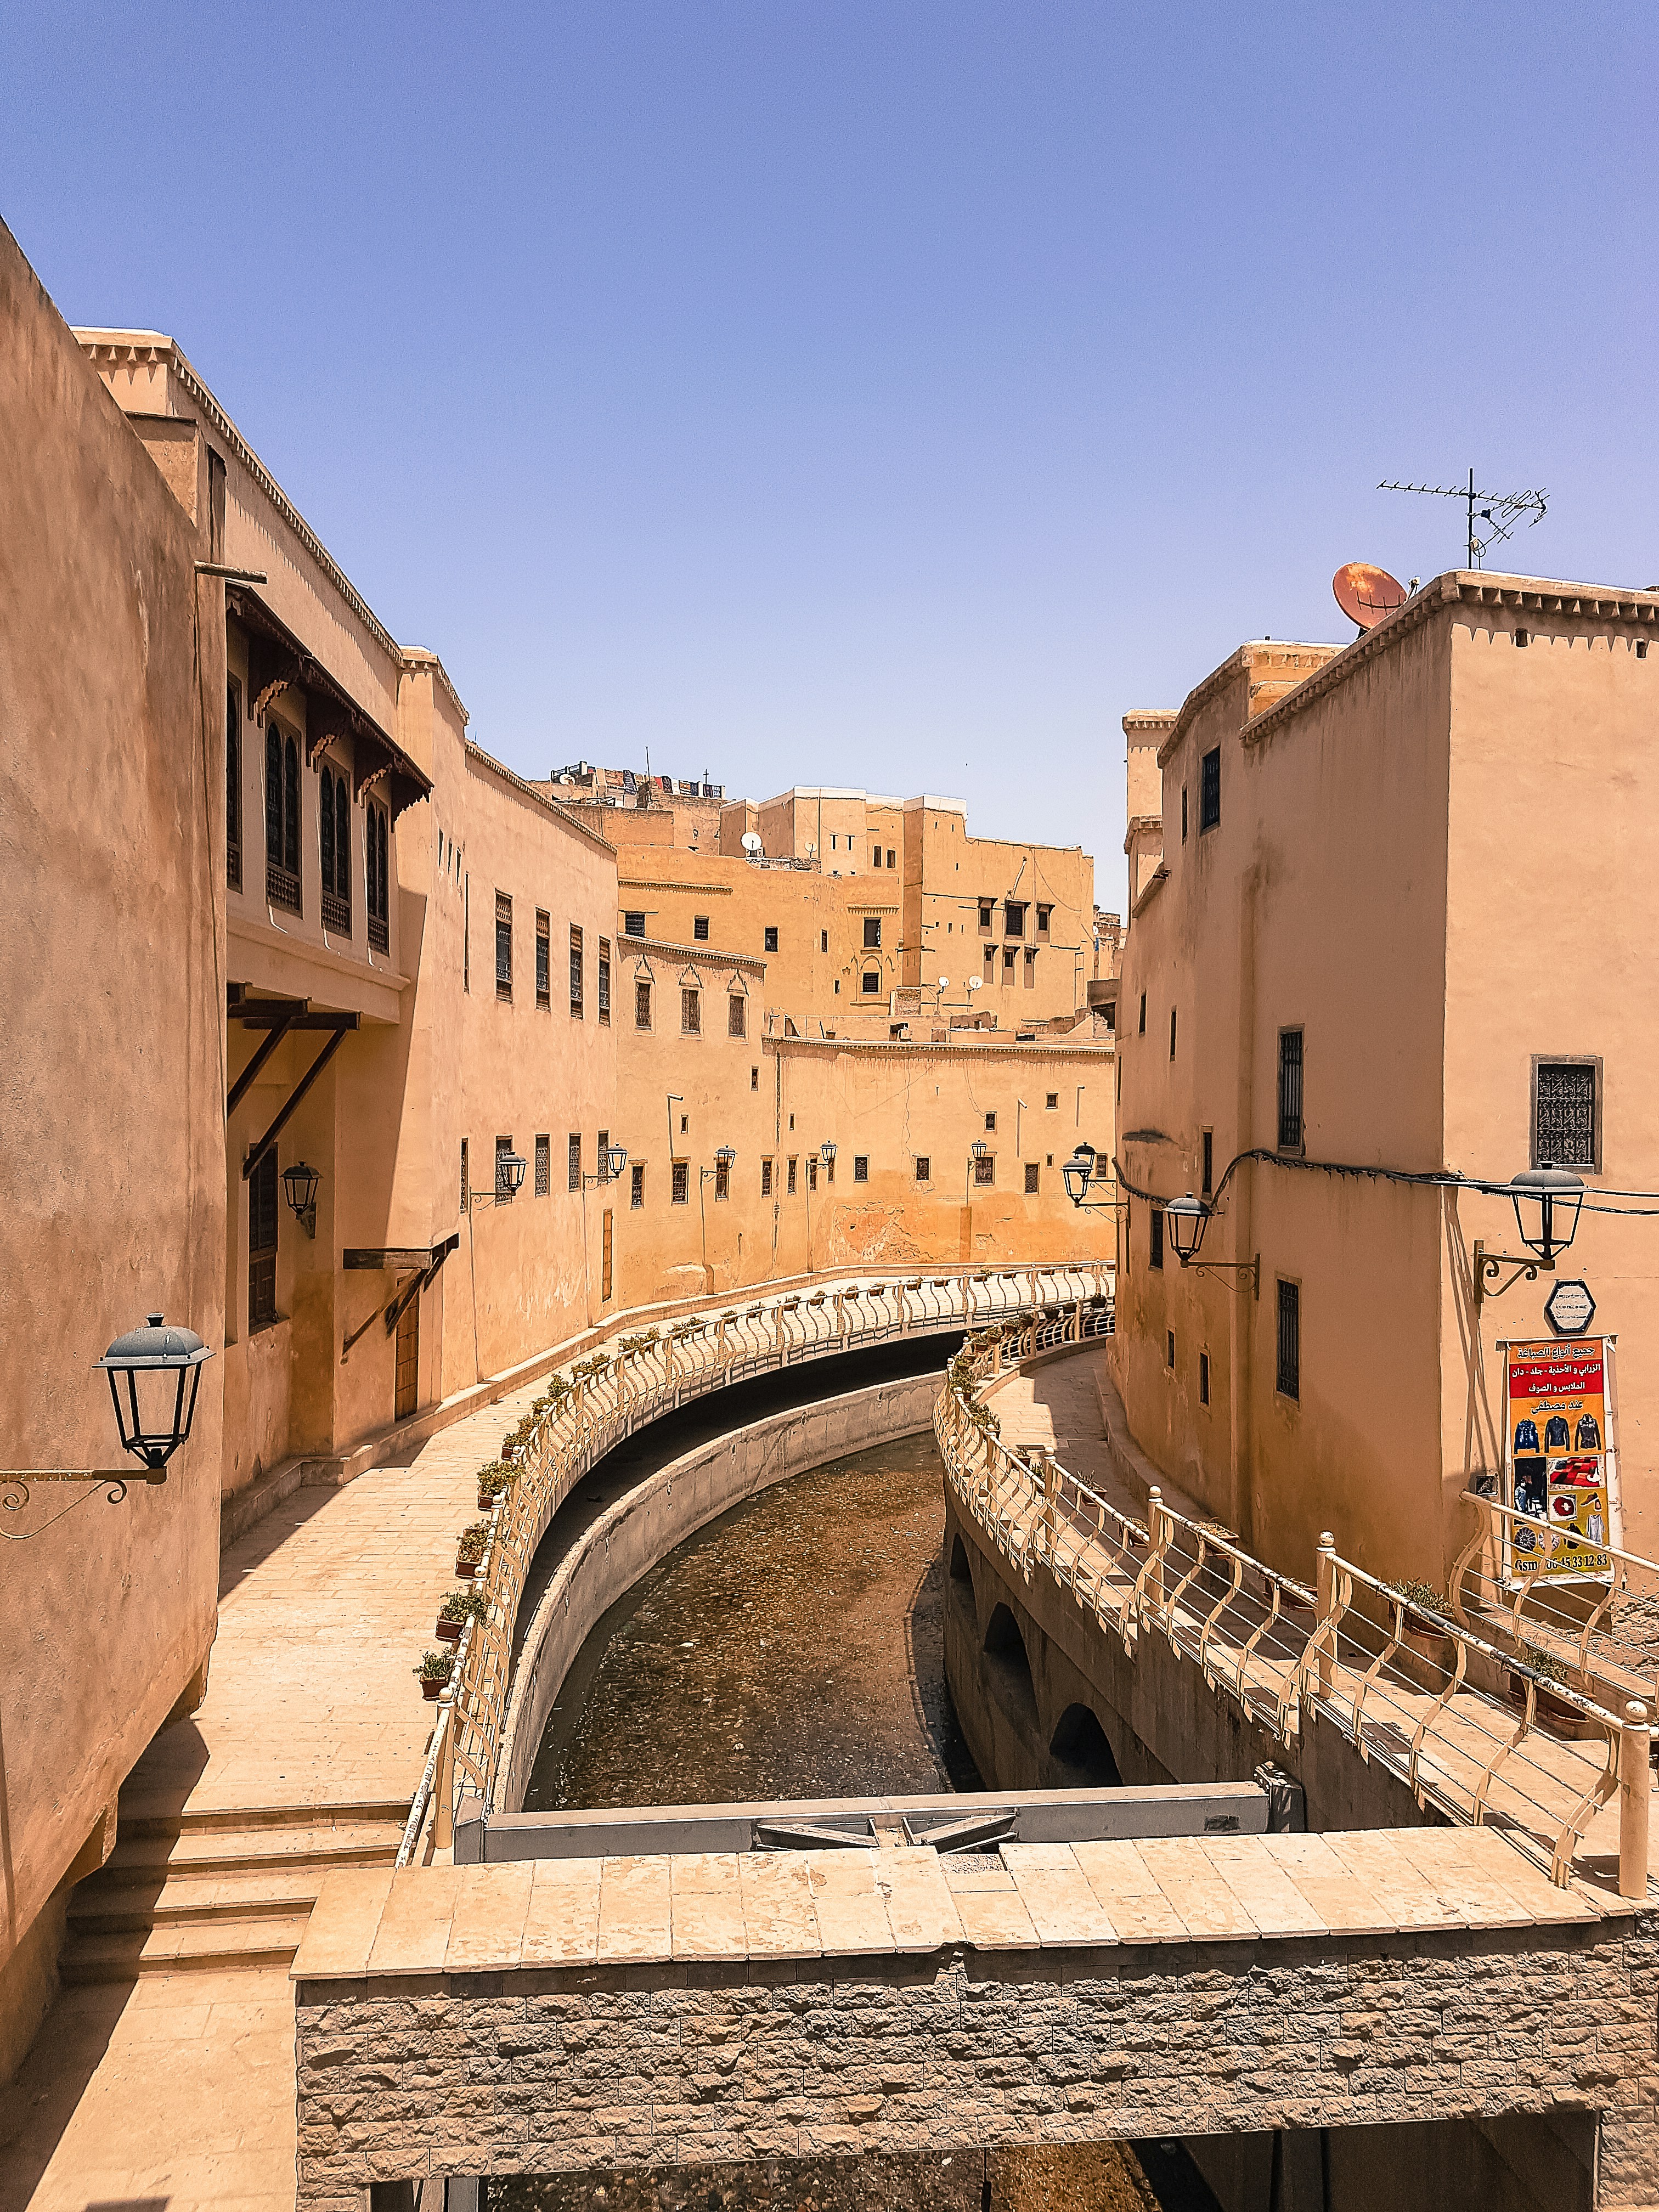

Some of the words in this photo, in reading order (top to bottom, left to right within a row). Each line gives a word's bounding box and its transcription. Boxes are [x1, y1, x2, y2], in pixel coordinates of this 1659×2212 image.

[1518, 1348, 1550, 1359] الصباغة
[1552, 1344, 1570, 1359] أنواع
[1573, 1348, 1594, 1358] جميع
[1530, 1367, 1543, 1375] جلد
[1548, 1364, 1572, 1375] الأحذية
[1579, 1363, 1600, 1376] الزرابي
[1528, 1383, 1551, 1393] الصوف
[1559, 1382, 1585, 1392] الملابس
[1531, 1401, 1566, 1414] مصطفى
[1568, 1400, 1583, 1409] عند
[1515, 1559, 1538, 1571] Gsm
[1572, 1556, 1583, 1568] 33
[1584, 1555, 1594, 1566] 12
[1597, 1554, 1607, 1566] 83
